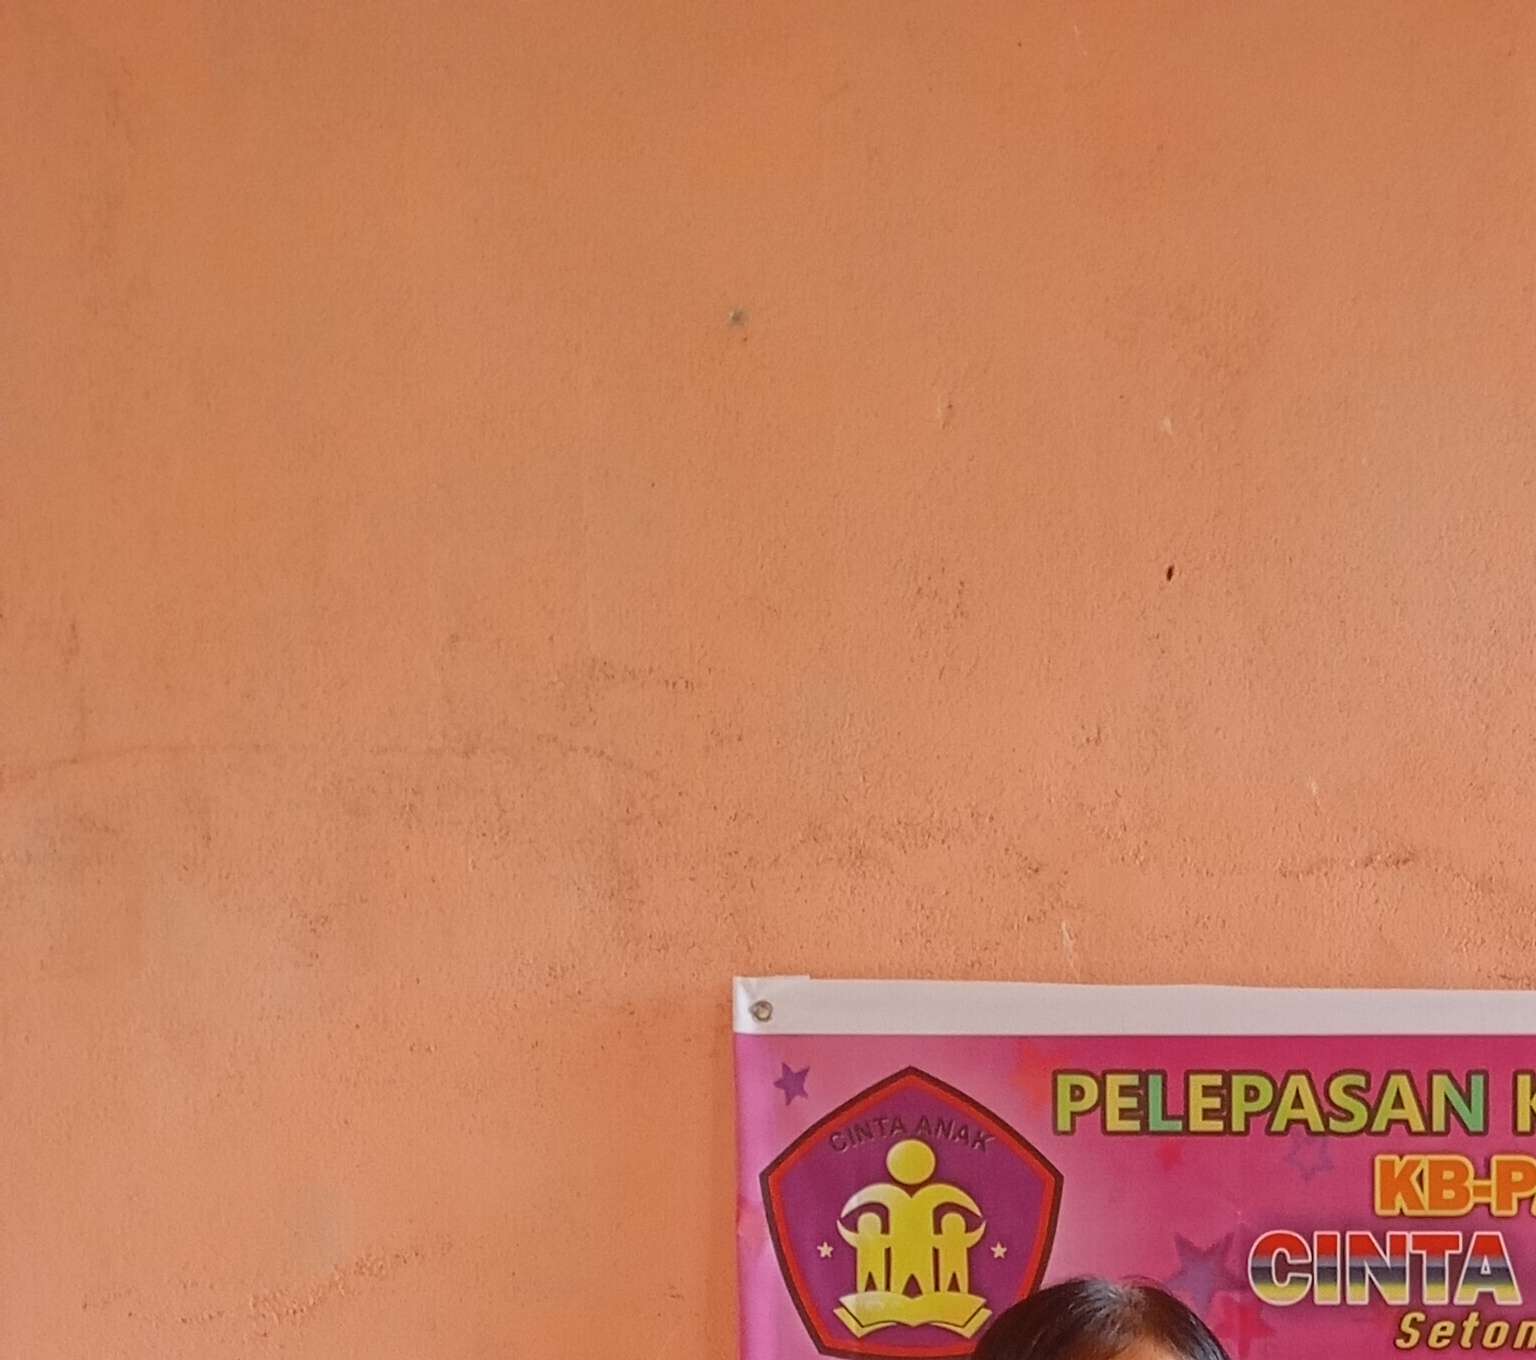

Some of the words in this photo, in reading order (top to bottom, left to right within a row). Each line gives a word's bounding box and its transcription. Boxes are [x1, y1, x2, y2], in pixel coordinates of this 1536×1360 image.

[828, 1114, 905, 1153] CINTA
[915, 1114, 996, 1154] ANAK
[1053, 1070, 1487, 1136] PELEPASAN
[1248, 1229, 1524, 1307] CINTA
